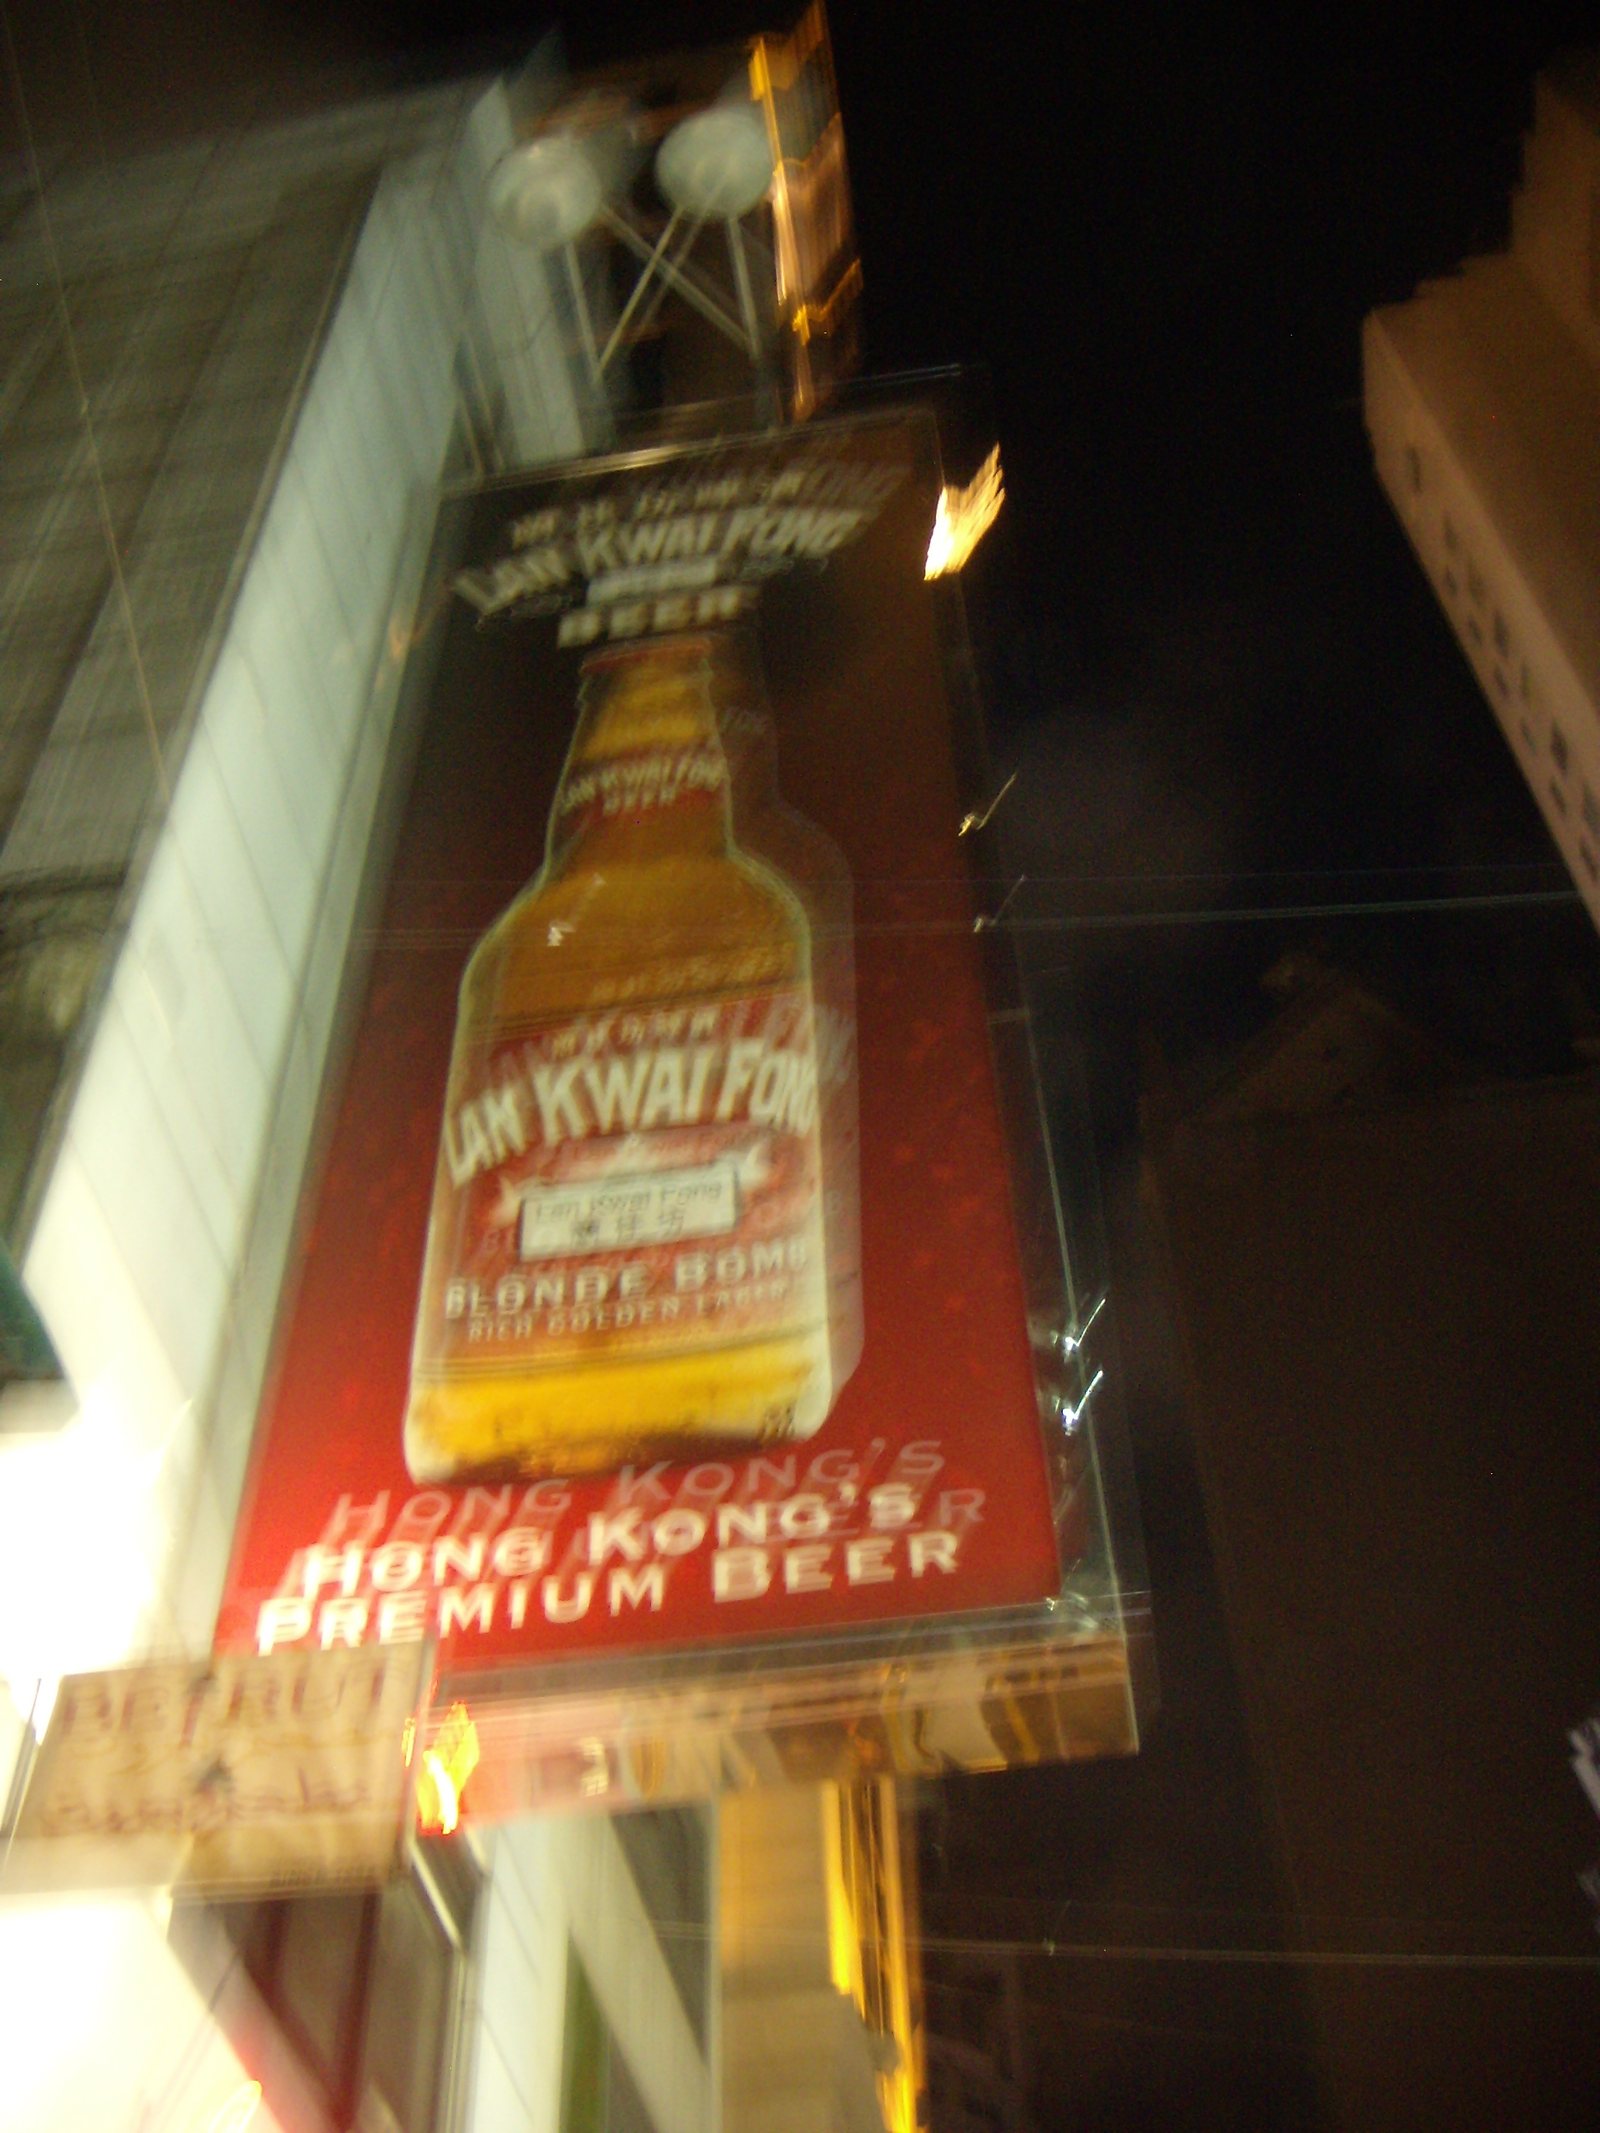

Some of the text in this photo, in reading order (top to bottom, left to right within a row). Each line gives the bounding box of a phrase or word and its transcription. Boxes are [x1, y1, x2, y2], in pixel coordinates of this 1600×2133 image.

[578, 508, 716, 580] KWAI
[446, 1088, 526, 1188] LAN
[532, 1048, 710, 1146] KWAI
[446, 1264, 648, 1320] BLONDE
[468, 1314, 534, 1342] RICH
[547, 1298, 680, 1334] GOLDEN
[304, 1482, 918, 1598] HONG KONG'S
[257, 1532, 960, 1656] PREMIUM BEER
